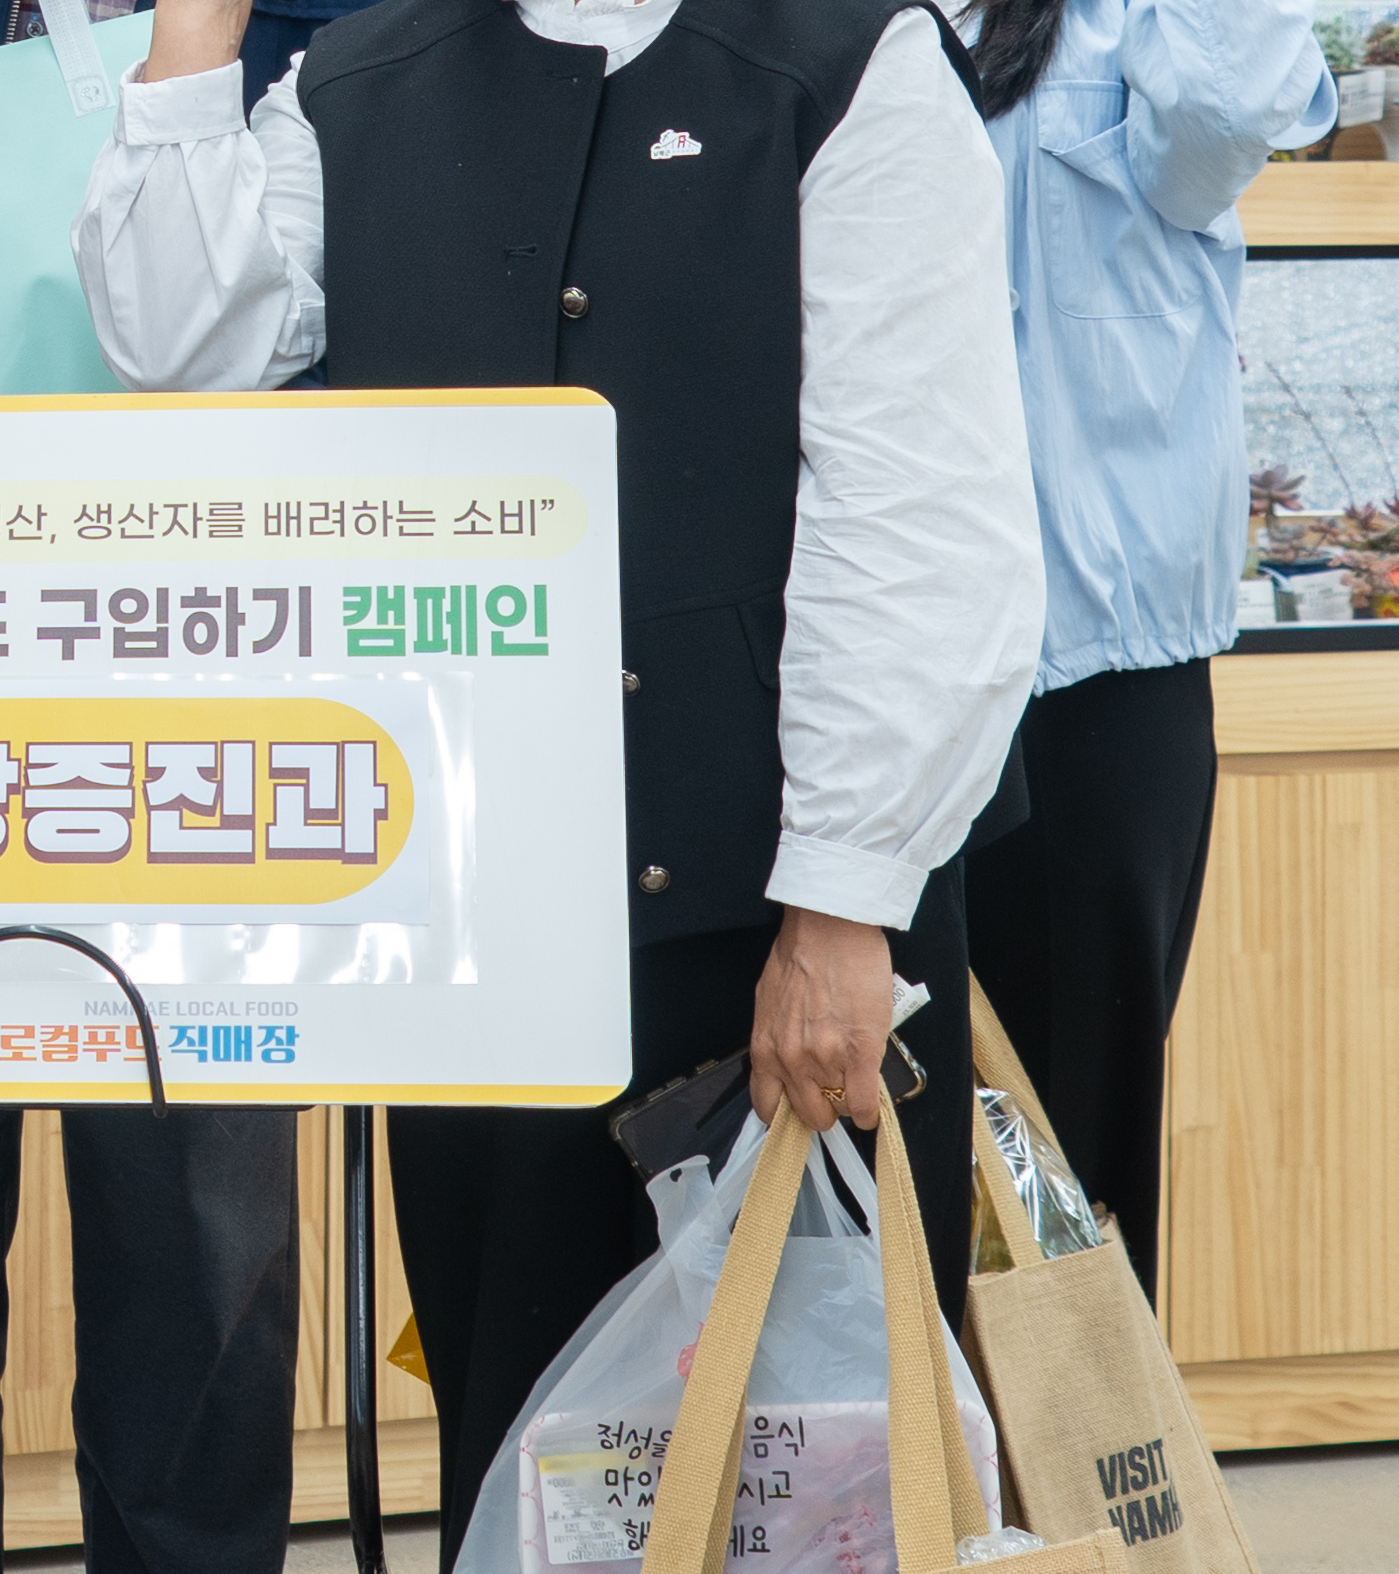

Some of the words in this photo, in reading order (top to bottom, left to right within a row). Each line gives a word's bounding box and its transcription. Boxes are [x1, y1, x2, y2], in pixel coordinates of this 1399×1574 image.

[74, 502, 245, 540] 생산자를
[264, 500, 436, 538] 배려하는
[453, 498, 555, 536] 소비”
[37, 586, 312, 660] 구입하기
[342, 584, 550, 657] 캠페인
[84, 1000, 170, 1017] NAMAE
[175, 1001, 241, 1017] LOCAL
[245, 1002, 299, 1016] FOOD
[168, 1025, 300, 1065] 직매장
[750, 1416, 805, 1458] 음식
[605, 1466, 662, 1507] 맛있
[738, 1471, 792, 1506] 시고
[1096, 1438, 1168, 1500] VISIT
